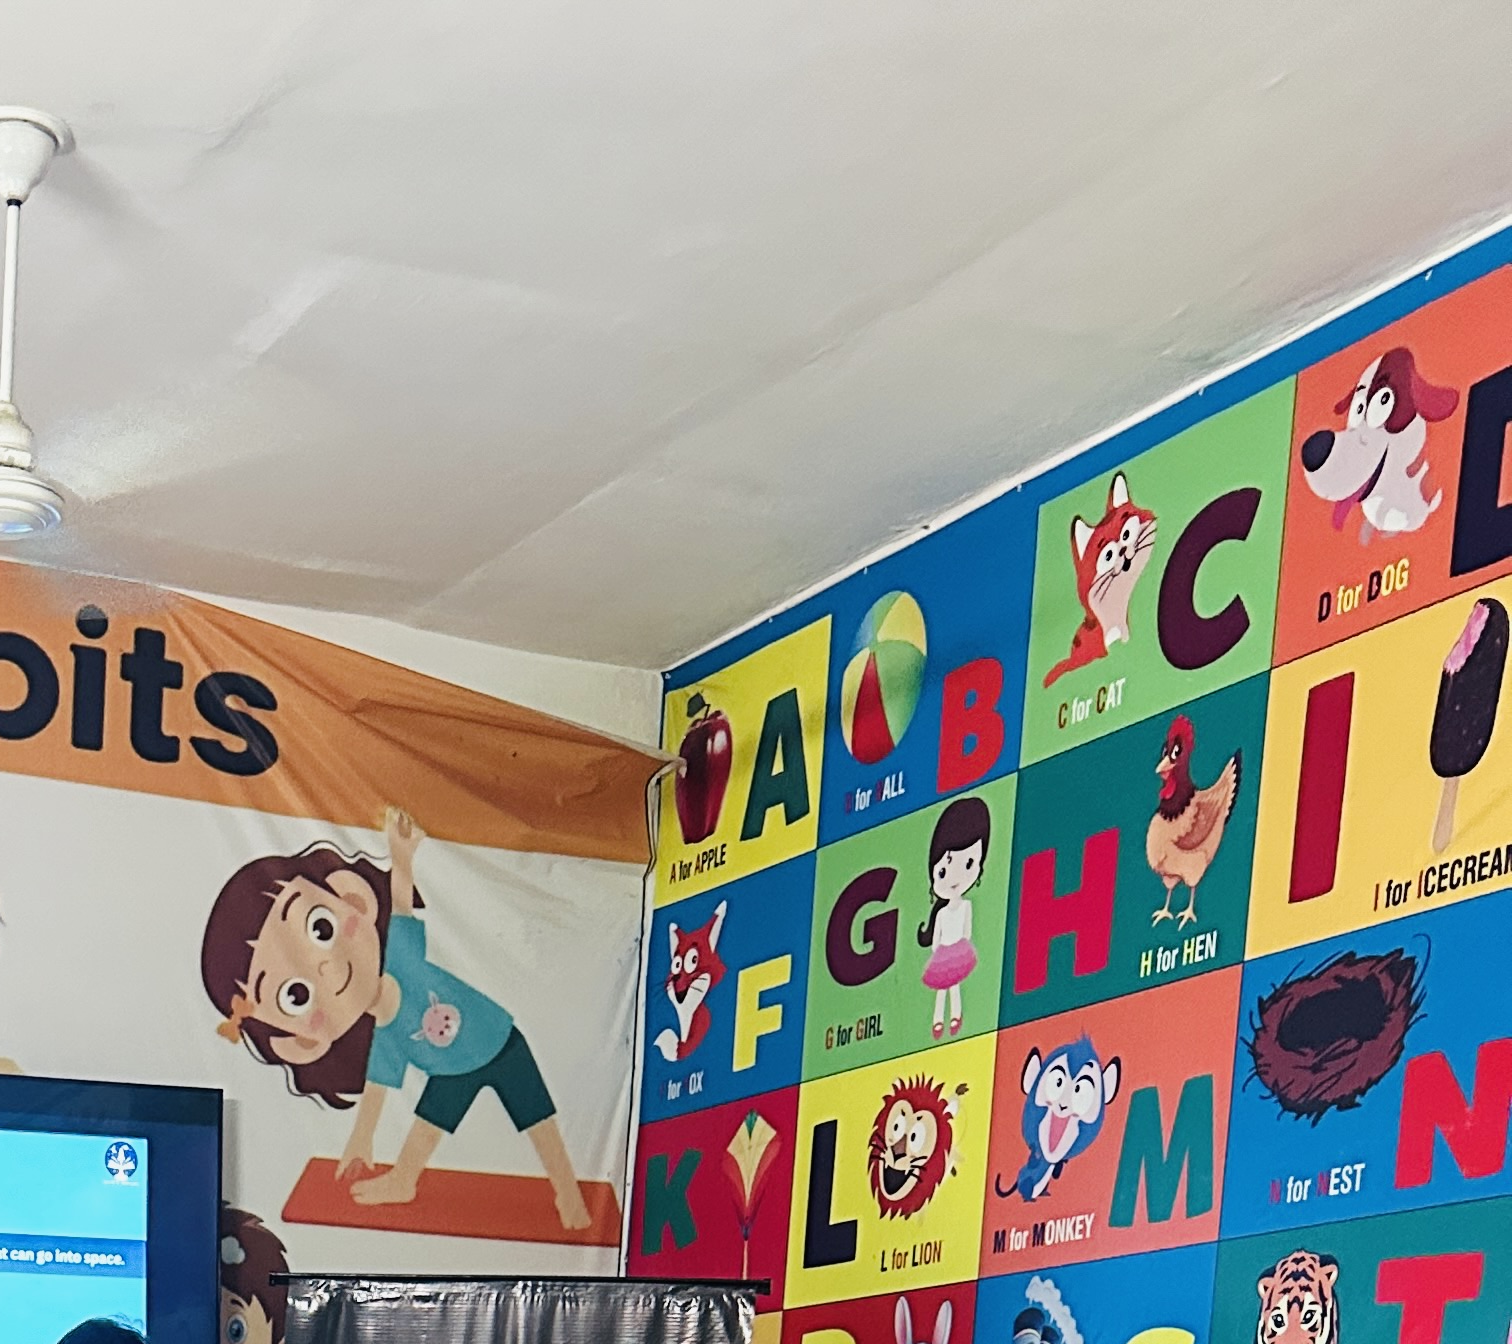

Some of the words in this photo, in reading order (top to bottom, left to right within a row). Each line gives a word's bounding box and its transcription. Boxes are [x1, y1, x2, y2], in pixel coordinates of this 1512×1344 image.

[1157, 487, 1262, 670] C
[1318, 592, 1331, 622] D
[1336, 579, 1363, 615] for
[1366, 557, 1410, 603] DOG
[936, 657, 1005, 794] B
[1058, 703, 1068, 729] C
[1071, 697, 1093, 725] for
[1097, 678, 1126, 714] CAT
[740, 687, 810, 841] A
[855, 788, 872, 811] for
[1288, 671, 1354, 904] I
[669, 863, 676, 885] A
[694, 844, 727, 876] APPLE
[1385, 880, 1412, 908] for
[825, 867, 898, 986] G
[1014, 827, 1120, 994] H
[1141, 953, 1152, 977] H
[1156, 947, 1179, 974] for
[1183, 931, 1217, 966] HEN
[732, 954, 792, 1072] F
[825, 1025, 834, 1050] G
[837, 1022, 852, 1048] for
[856, 1014, 884, 1041] GIRL
[1108, 1074, 1214, 1228] M
[1394, 1037, 1512, 1189] N
[641, 1148, 702, 1256] K
[803, 1119, 857, 1269] L
[1286, 1176, 1312, 1203] for
[1317, 1163, 1366, 1196] NEST
[10, 1249, 35, 1261] can
[36, 1250, 53, 1266] go
[55, 1248, 83, 1263] into
[83, 1252, 125, 1268] space.
[880, 1251, 888, 1272] L
[891, 1247, 908, 1270] for
[911, 1241, 942, 1266] LION
[993, 1229, 1006, 1254] M
[1009, 1227, 1029, 1251] for
[1032, 1213, 1095, 1248] MONKEY
